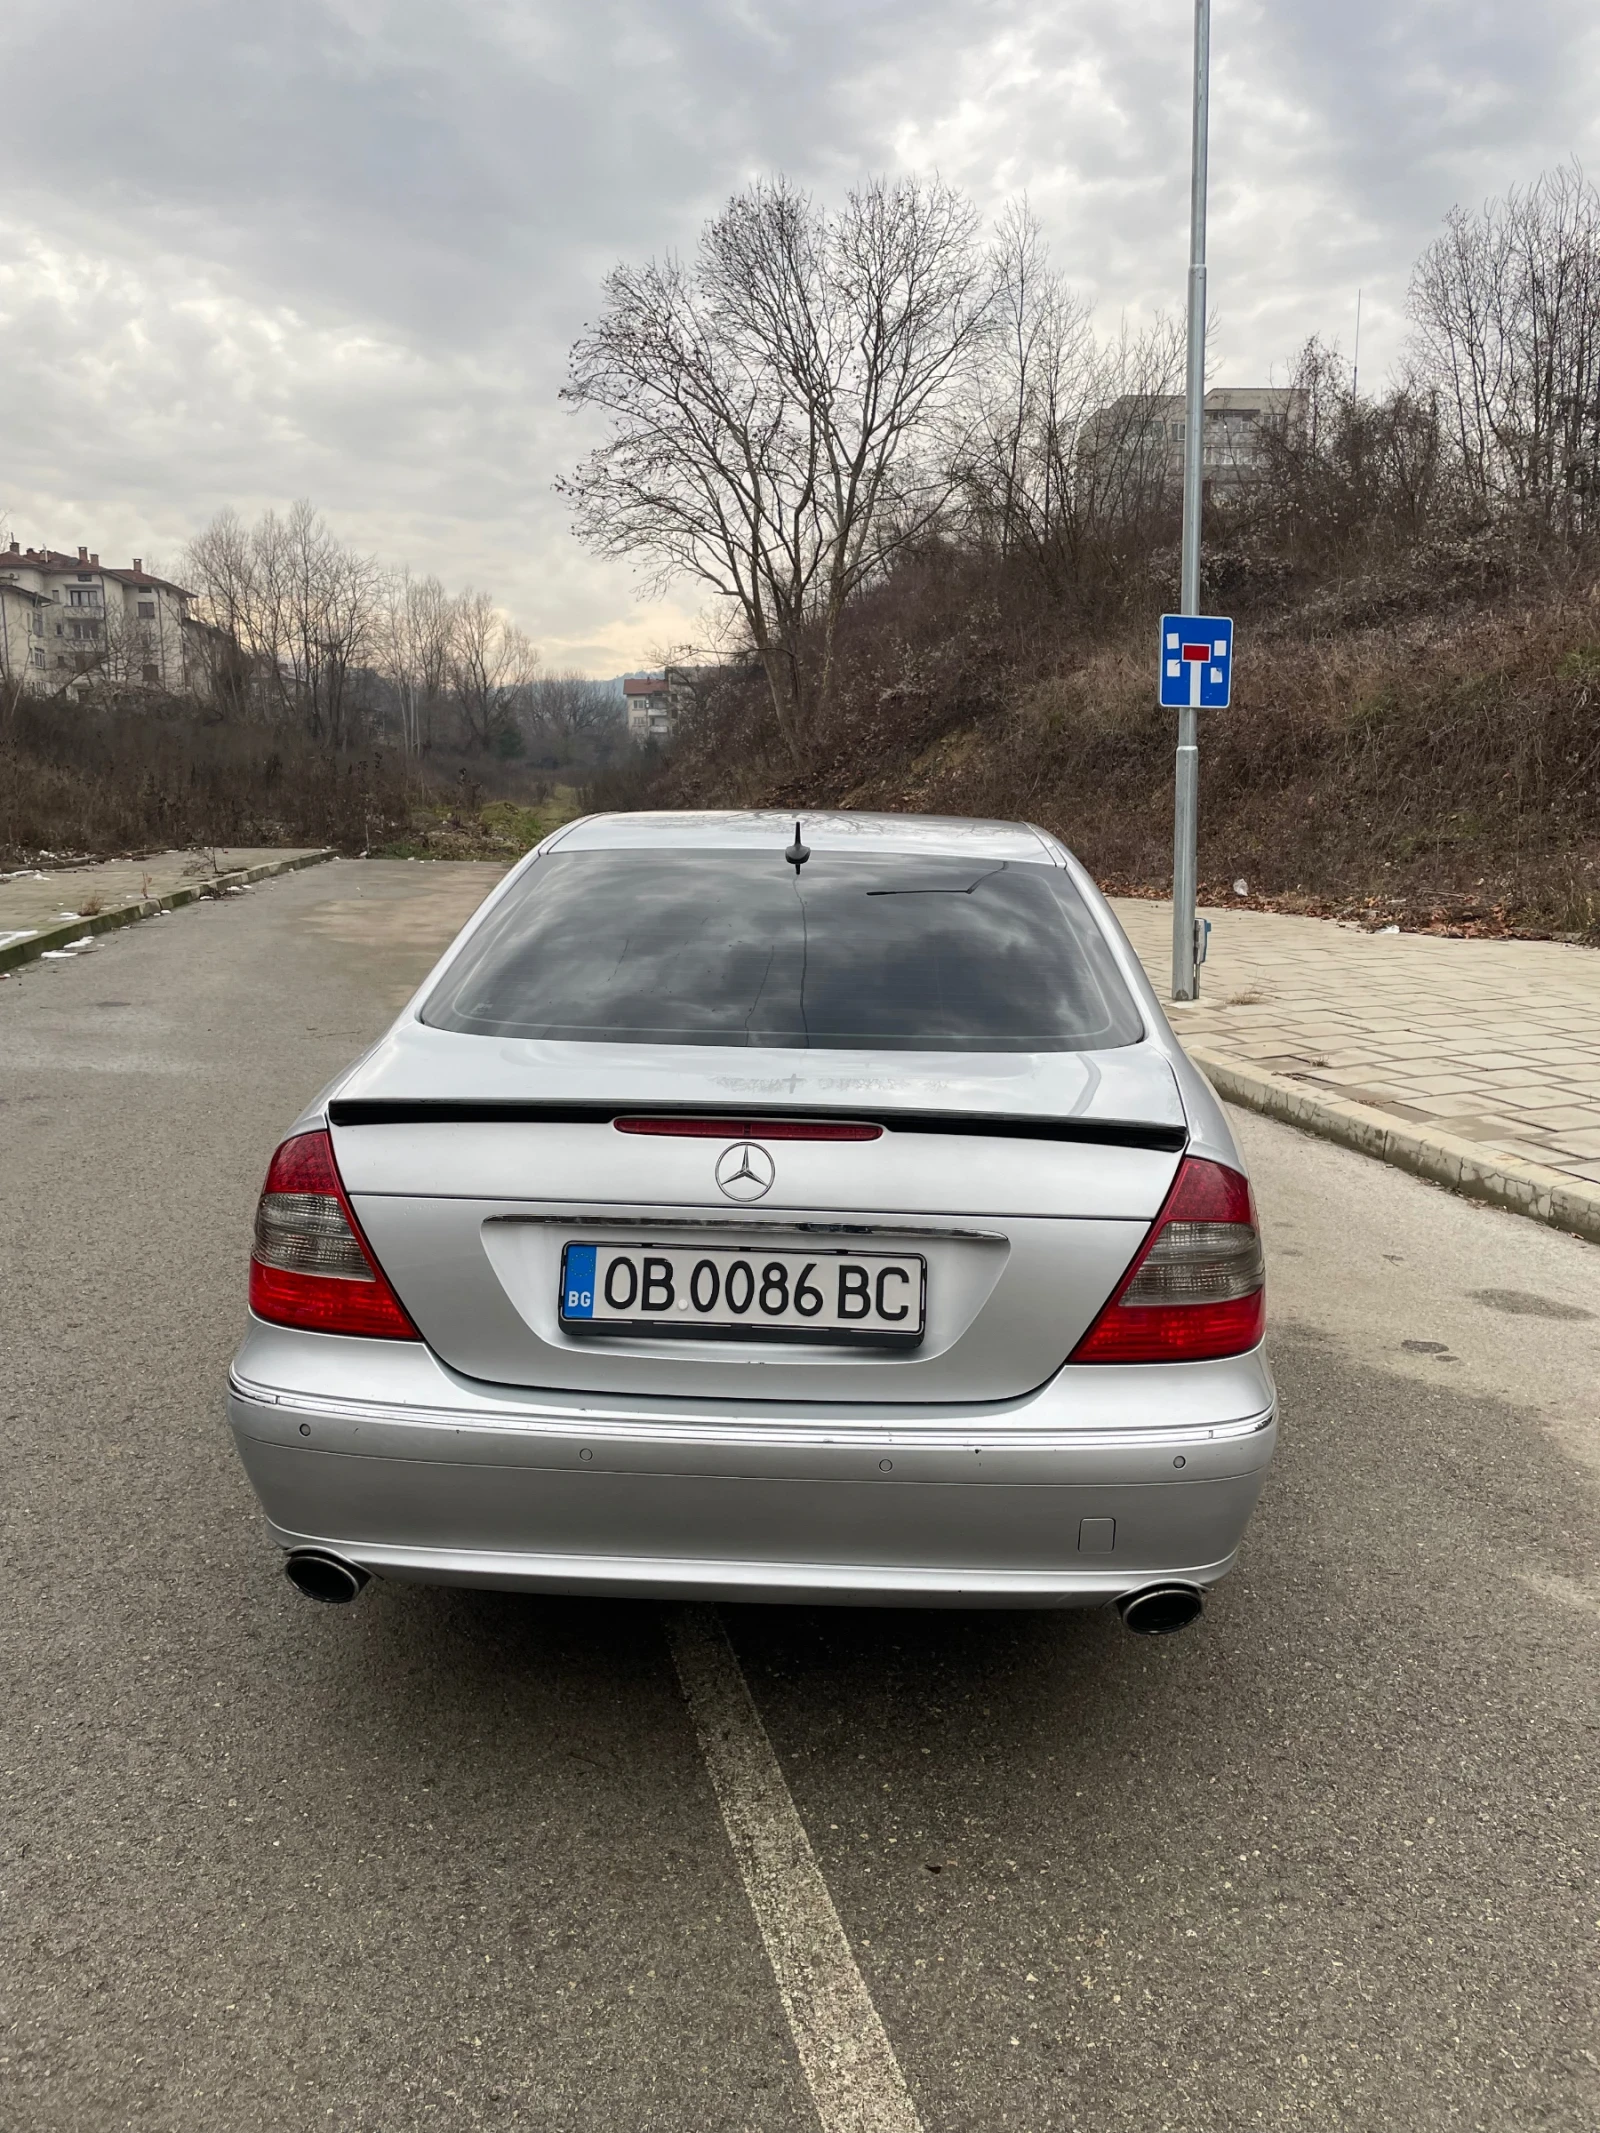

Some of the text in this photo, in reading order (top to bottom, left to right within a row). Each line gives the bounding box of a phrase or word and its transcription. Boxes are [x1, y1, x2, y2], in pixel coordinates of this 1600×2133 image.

[567, 1290, 592, 1308] BG
[604, 1256, 910, 1321] OB 0086 BC
